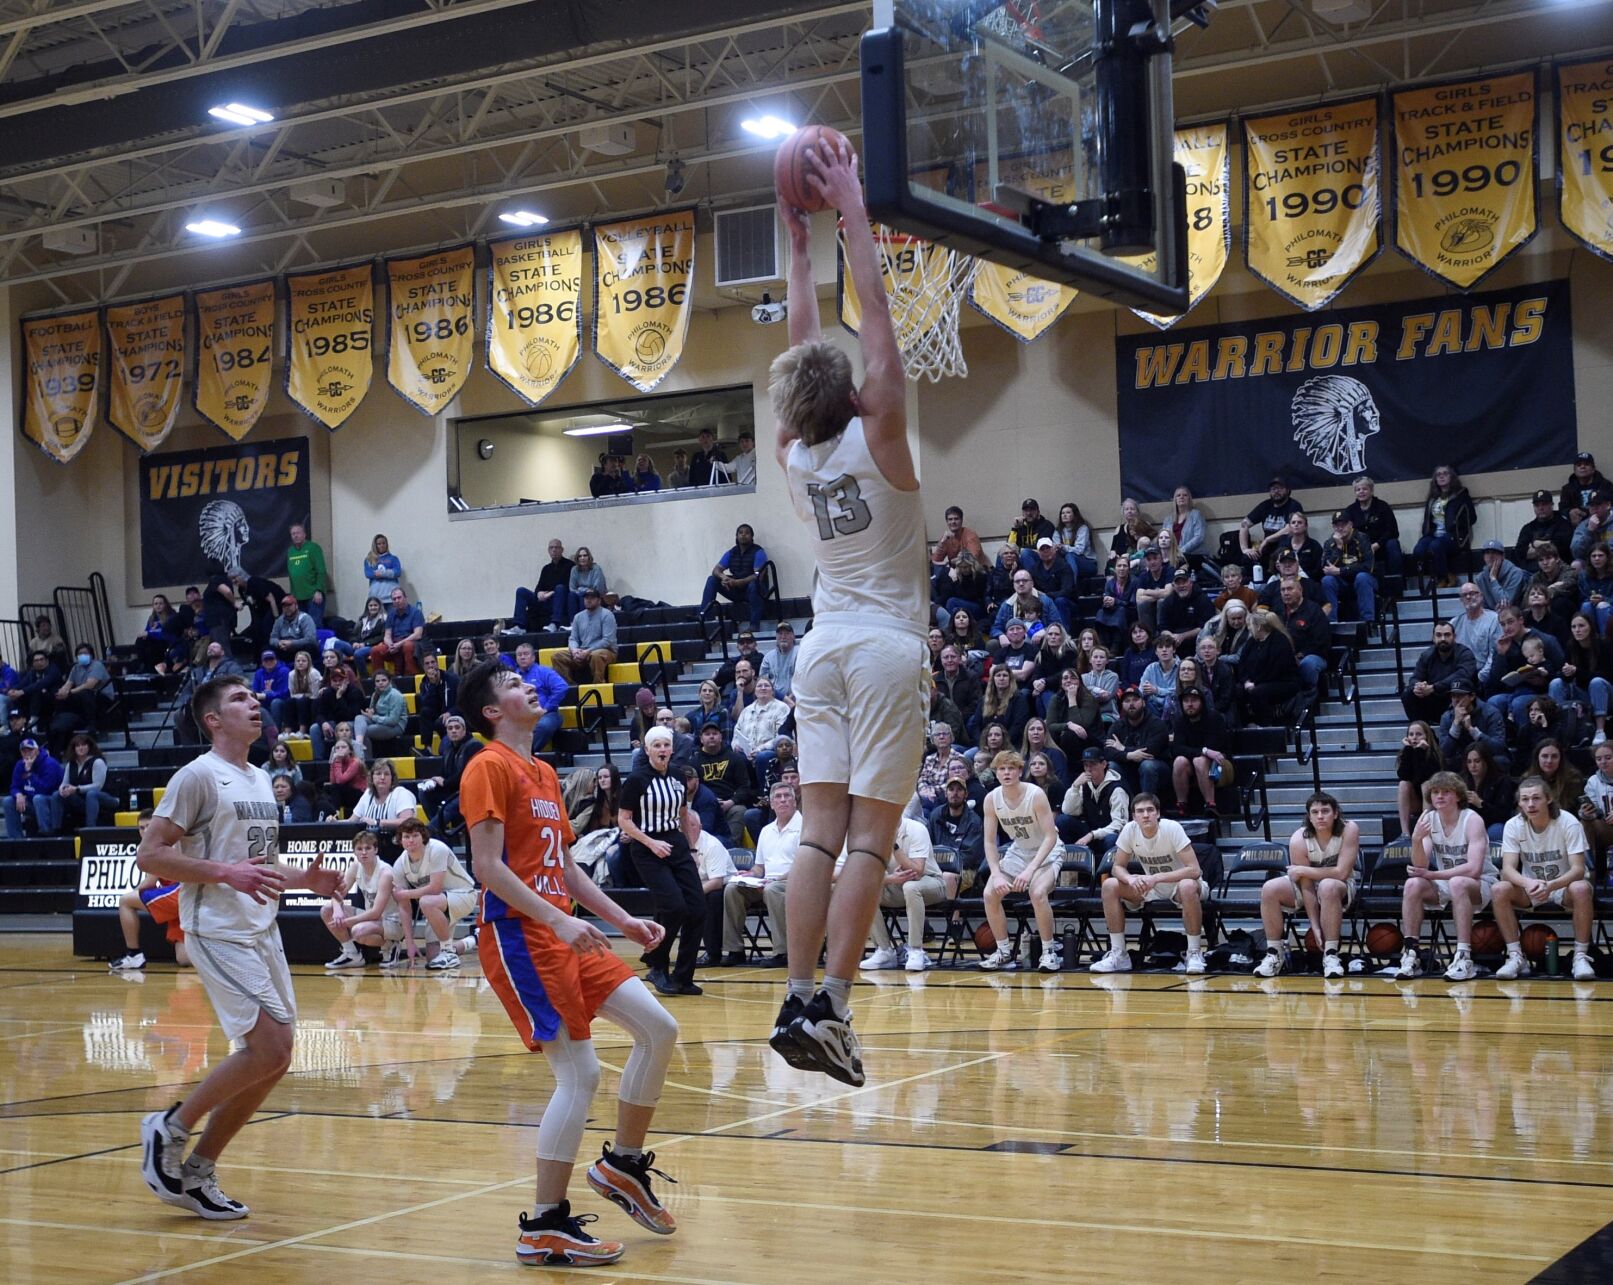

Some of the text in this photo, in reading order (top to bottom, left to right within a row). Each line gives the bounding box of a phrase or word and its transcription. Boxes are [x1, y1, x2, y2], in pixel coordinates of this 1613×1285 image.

[1435, 84, 1490, 101] GIRLS
[1564, 82, 1613, 96] TRAC
[1399, 91, 1531, 121] TRACK & FIELD
[1288, 112, 1333, 128] GIRLS
[1301, 117, 1374, 137] COUNTRY
[1424, 115, 1504, 140] STATE
[1274, 140, 1348, 164] STATE
[1402, 129, 1530, 167] CHAMPIONS
[1412, 160, 1520, 198] 1990
[1434, 207, 1499, 231] PHILOMATH
[514, 238, 552, 251] GIRLS
[617, 246, 674, 265] SATE
[419, 257, 447, 270] GIRLS
[427, 261, 473, 277] COUNTRY
[510, 264, 562, 282] STATE
[408, 280, 457, 299] STATE
[497, 277, 580, 303] CHAMPIONS
[613, 283, 687, 314] 1986
[307, 297, 356, 313] STATE
[507, 301, 575, 330] 1986
[29, 321, 94, 338] FOOTBALL
[214, 312, 256, 329] STATE
[295, 309, 372, 333] CHAMPIONS
[405, 315, 469, 345] 1986
[627, 321, 673, 340] PHILOMATH
[126, 326, 168, 343] STATE
[305, 330, 369, 358] 1985
[1134, 297, 1548, 389] WARRIOR FANS
[42, 341, 84, 356] STATE
[519, 337, 560, 356] PHILOMATH
[213, 345, 271, 373] 1984
[120, 359, 181, 385] 1972
[316, 397, 356, 414] WARRIORS
[150, 451, 299, 500] VISITORS
[806, 473, 872, 540] 13
[247, 826, 279, 865] 22
[287, 840, 317, 853] HOME
[319, 840, 333, 852] OF
[85, 859, 142, 890] PHILO
